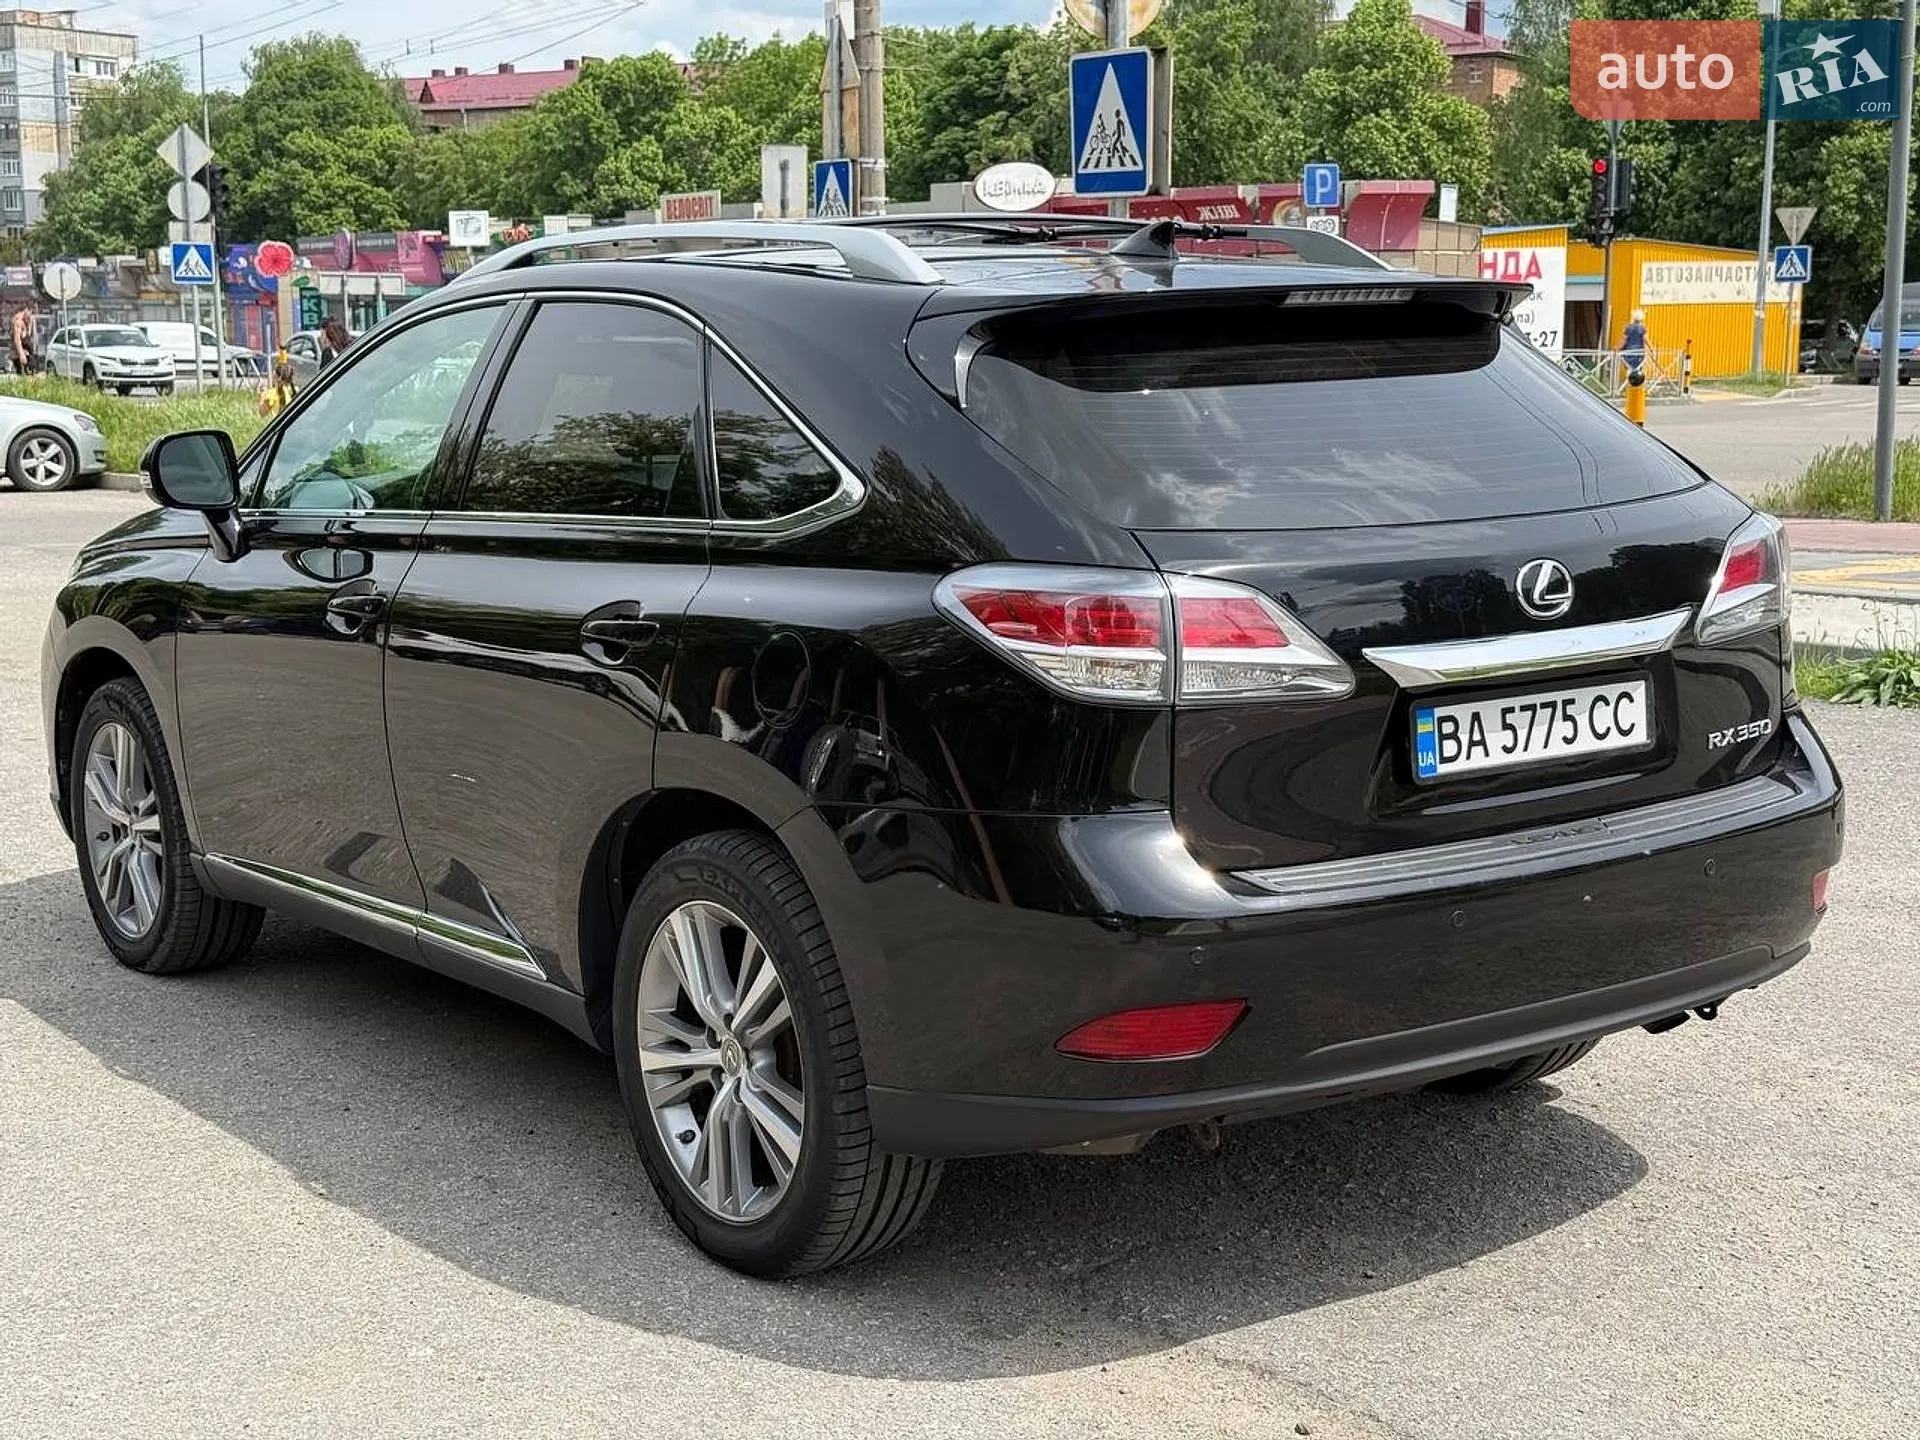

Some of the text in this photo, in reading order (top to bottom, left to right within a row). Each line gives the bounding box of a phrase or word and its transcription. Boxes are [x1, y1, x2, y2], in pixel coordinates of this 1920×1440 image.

[1315, 168, 1332, 204] P
[1437, 691, 1636, 765] BA 5775 CC
[1418, 750, 1435, 767] UA
